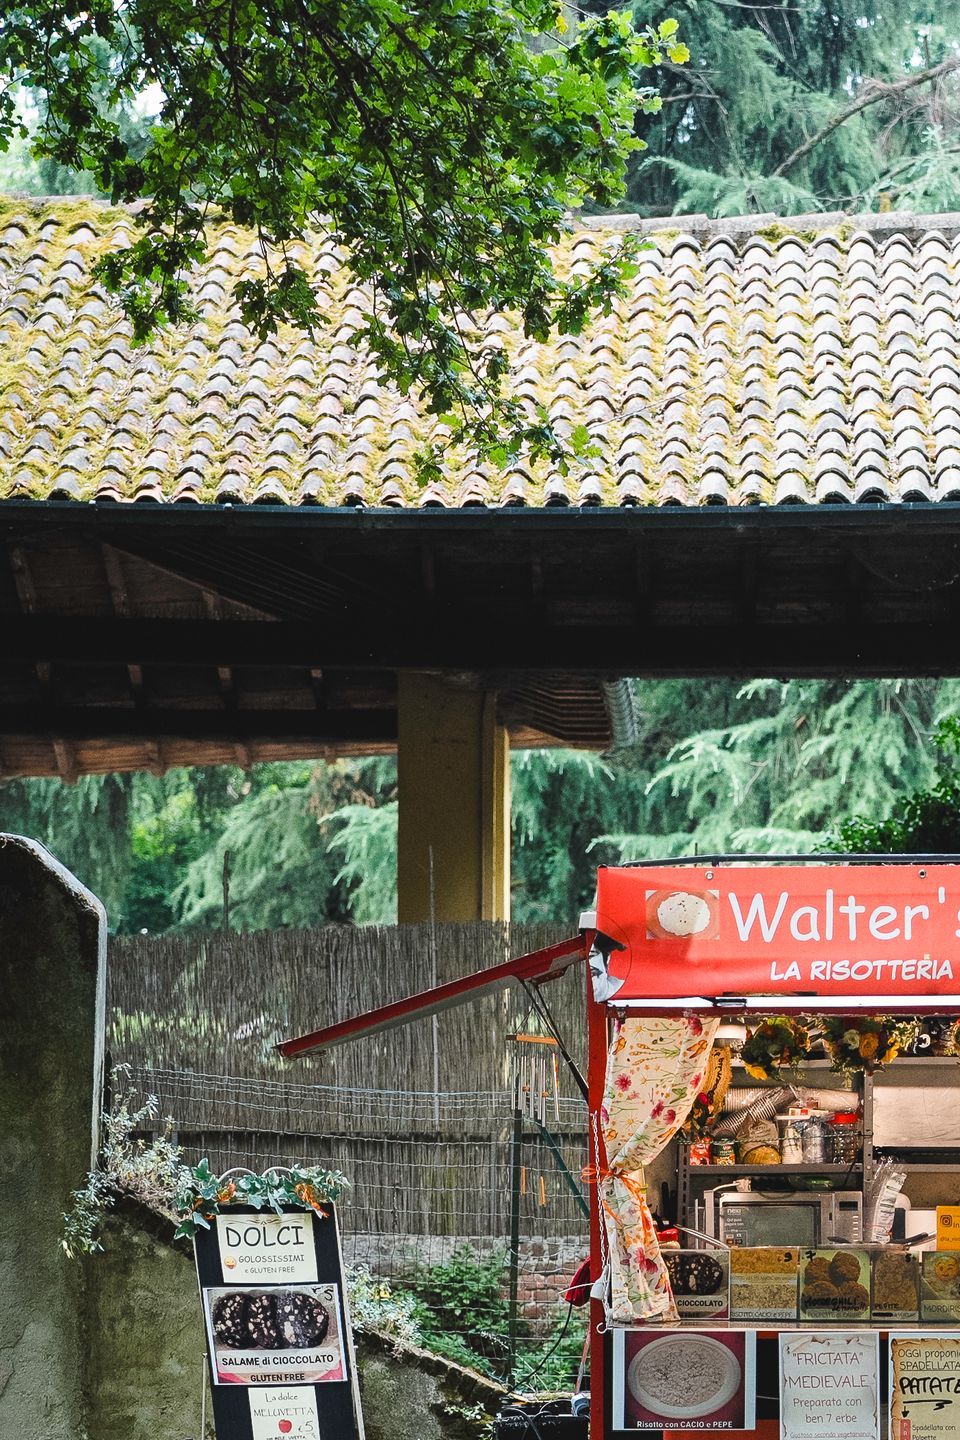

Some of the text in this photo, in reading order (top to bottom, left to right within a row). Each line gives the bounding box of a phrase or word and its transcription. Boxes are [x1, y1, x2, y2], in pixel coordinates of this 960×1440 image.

[770, 961, 801, 981] LA
[810, 958, 953, 981] RISOTTERIA
[226, 1225, 305, 1248] DOLCI
[238, 1254, 305, 1263] GOLOSSISSIMI
[898, 1348, 921, 1358] OGGI
[222, 1354, 334, 1366] SALAME di CIOCCOLATO
[250, 1372, 306, 1383] GLUTEN FREE
[788, 1374, 869, 1389] MEDIEVALE
[265, 1392, 299, 1403] La dolce
[793, 1397, 862, 1410] Preparata con
[253, 1407, 315, 1417] MELUVETTA
[805, 1413, 857, 1424] ben 7 erbe
[305, 1420, 314, 1432] 5
[636, 1420, 664, 1429] Risotto
[680, 1420, 705, 1428] CACIO
[712, 1420, 733, 1428] PEPE
[912, 1424, 944, 1433] Spadellata
